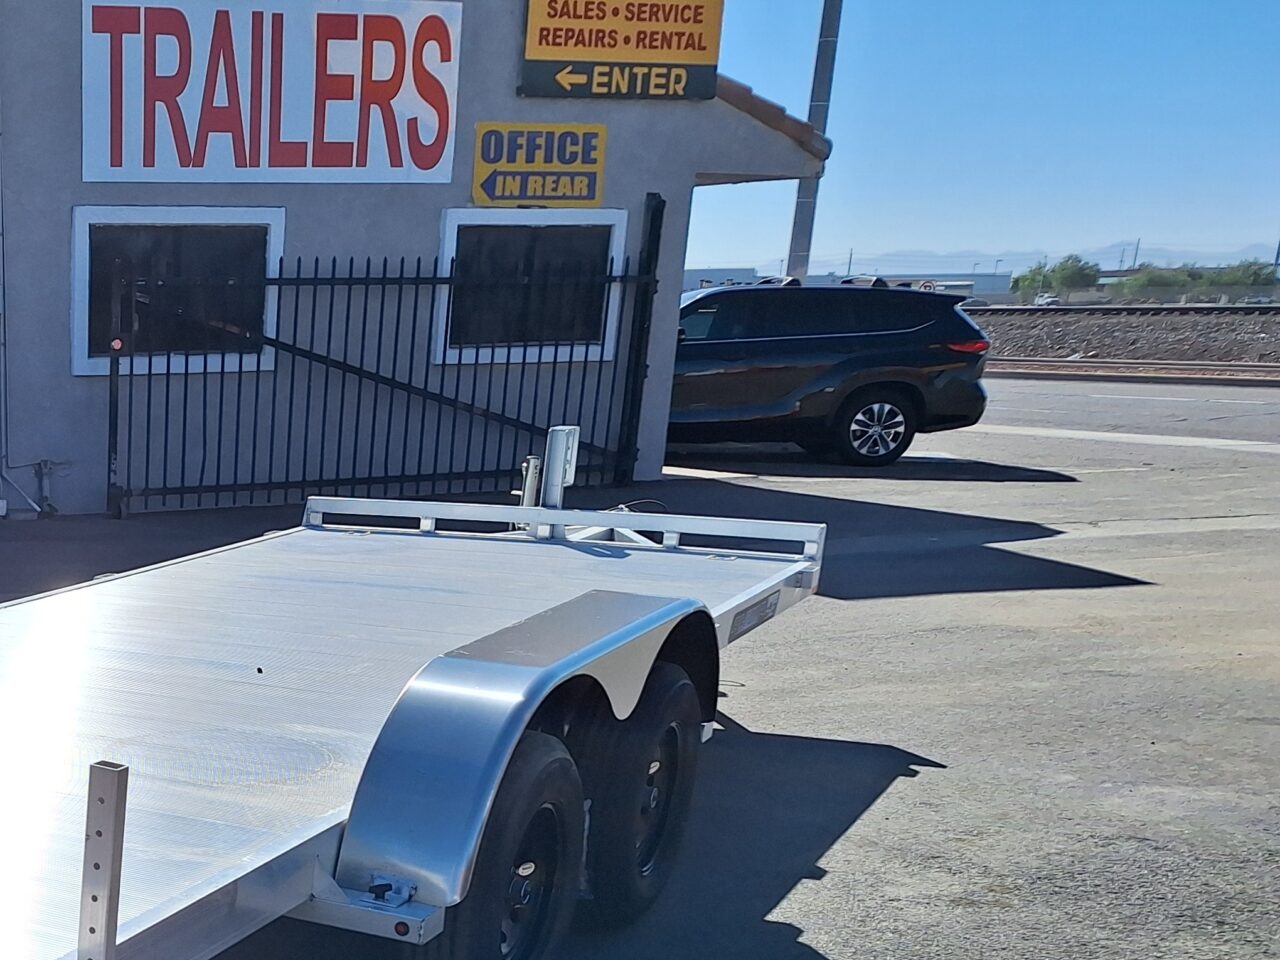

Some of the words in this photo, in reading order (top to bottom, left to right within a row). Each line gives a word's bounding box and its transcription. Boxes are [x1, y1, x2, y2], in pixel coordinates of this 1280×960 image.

[547, 0, 607, 20] SALES
[624, 3, 705, 24] SERVICE
[538, 27, 618, 48] REPAIRS
[636, 30, 707, 51] RENTAL
[92, 5, 452, 170] TRAILERS
[591, 65, 687, 96] ENTER
[481, 130, 599, 165] OFFICE
[495, 175, 520, 197] IN
[526, 175, 589, 197] REAR
